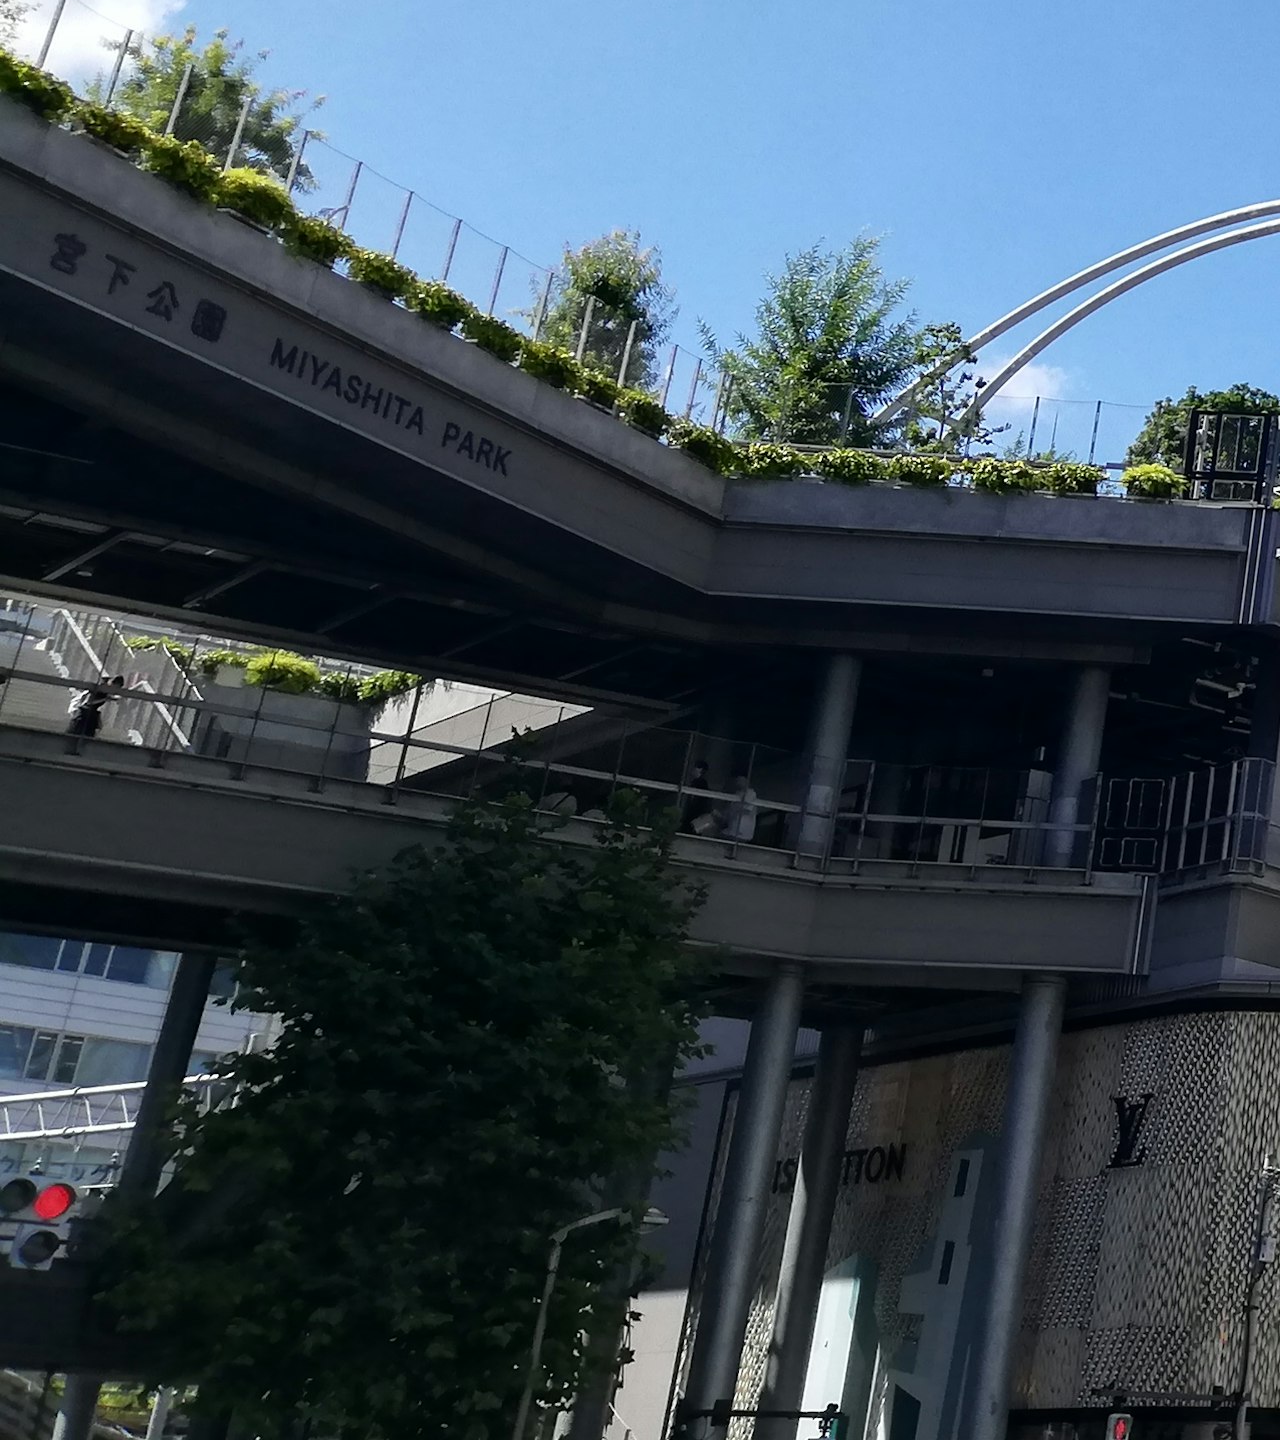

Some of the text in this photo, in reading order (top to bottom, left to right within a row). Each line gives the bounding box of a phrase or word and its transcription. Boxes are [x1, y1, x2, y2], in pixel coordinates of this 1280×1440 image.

[50, 232, 227, 342] 宮下公園
[270, 337, 513, 478] MIYASHITA PARK
